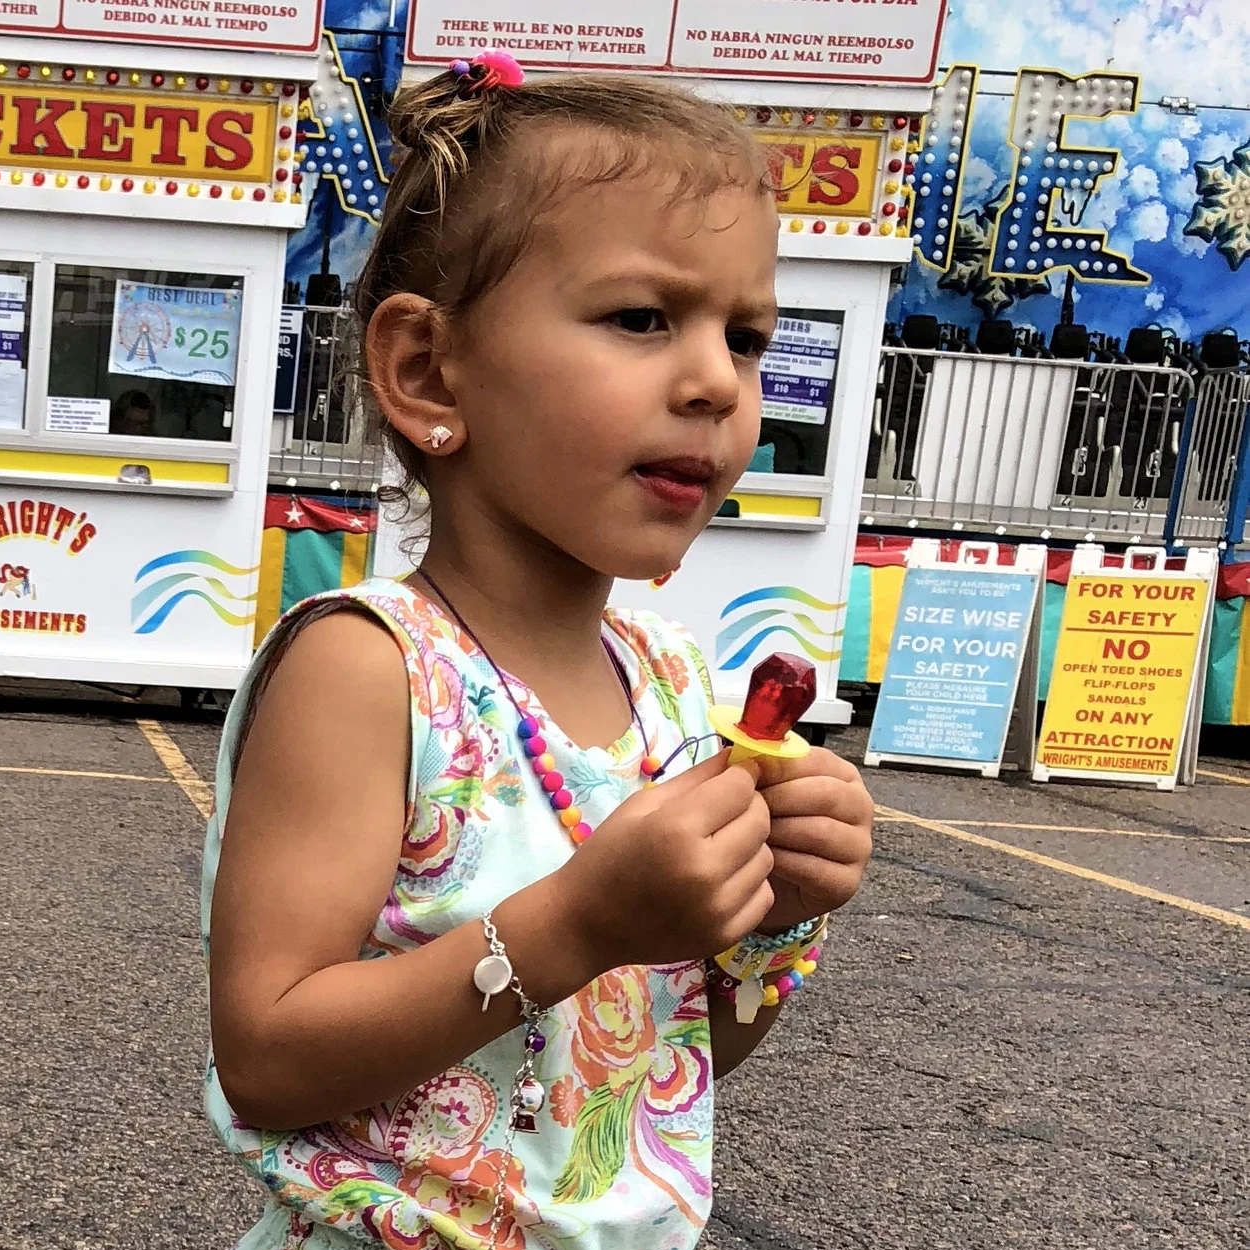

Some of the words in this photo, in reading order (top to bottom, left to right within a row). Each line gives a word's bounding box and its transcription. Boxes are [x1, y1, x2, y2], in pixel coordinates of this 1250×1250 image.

[154, 0, 210, 11] NINGUN
[214, 3, 297, 18] REEMBOLSO
[104, 10, 156, 23] DEBIDO
[161, 14, 178, 25] AL
[182, 17, 211, 28] MAL
[216, 18, 267, 31] TIEMPO
[442, 19, 489, 32] THERE
[493, 21, 527, 33] WILL
[531, 23, 549, 34] BE
[553, 24, 573, 35] NO
[577, 25, 644, 38] REFUNDS
[436, 35, 465, 47] DUE
[470, 37, 488, 48] TO
[492, 37, 573, 51] INCLEMENT
[578, 41, 646, 54] WEATHER
[687, 29, 707, 41] NO
[765, 32, 824, 46] NINGUN
[828, 35, 914, 49] REEMBOLSO
[713, 46, 767, 59] DEBIDO
[771, 49, 790, 61] AL
[794, 50, 824, 62] MAL
[828, 52, 882, 65] TIEMPO
[174, 326, 229, 360] $25
[1078, 582, 1124, 599] FOR
[1132, 584, 1196, 601] YOUR
[904, 605, 955, 625] SIZE
[962, 609, 1022, 629] WISE
[1087, 609, 1177, 627] SAFETY
[897, 635, 945, 654] FOR
[952, 638, 1017, 659] YOUR
[1102, 638, 1151, 661] NO
[914, 661, 990, 679] SAFETY
[1063, 663, 1098, 673] OPEN
[1101, 665, 1135, 676] TOED
[1139, 666, 1183, 678] SHOES
[932, 690, 961, 699] CHILD
[1083, 679, 1156, 691] FLIP-FLOPS
[1087, 694, 1146, 706] SANDALS
[1075, 709, 1104, 723] ON
[1109, 711, 1154, 726] ANY
[928, 742, 951, 751] WITH
[952, 744, 978, 754] CHILD
[1045, 731, 1174, 750] ATTRACTION
[1043, 752, 1093, 766] WRIGHT'S
[1095, 755, 1168, 771] AMUSEMENTS
